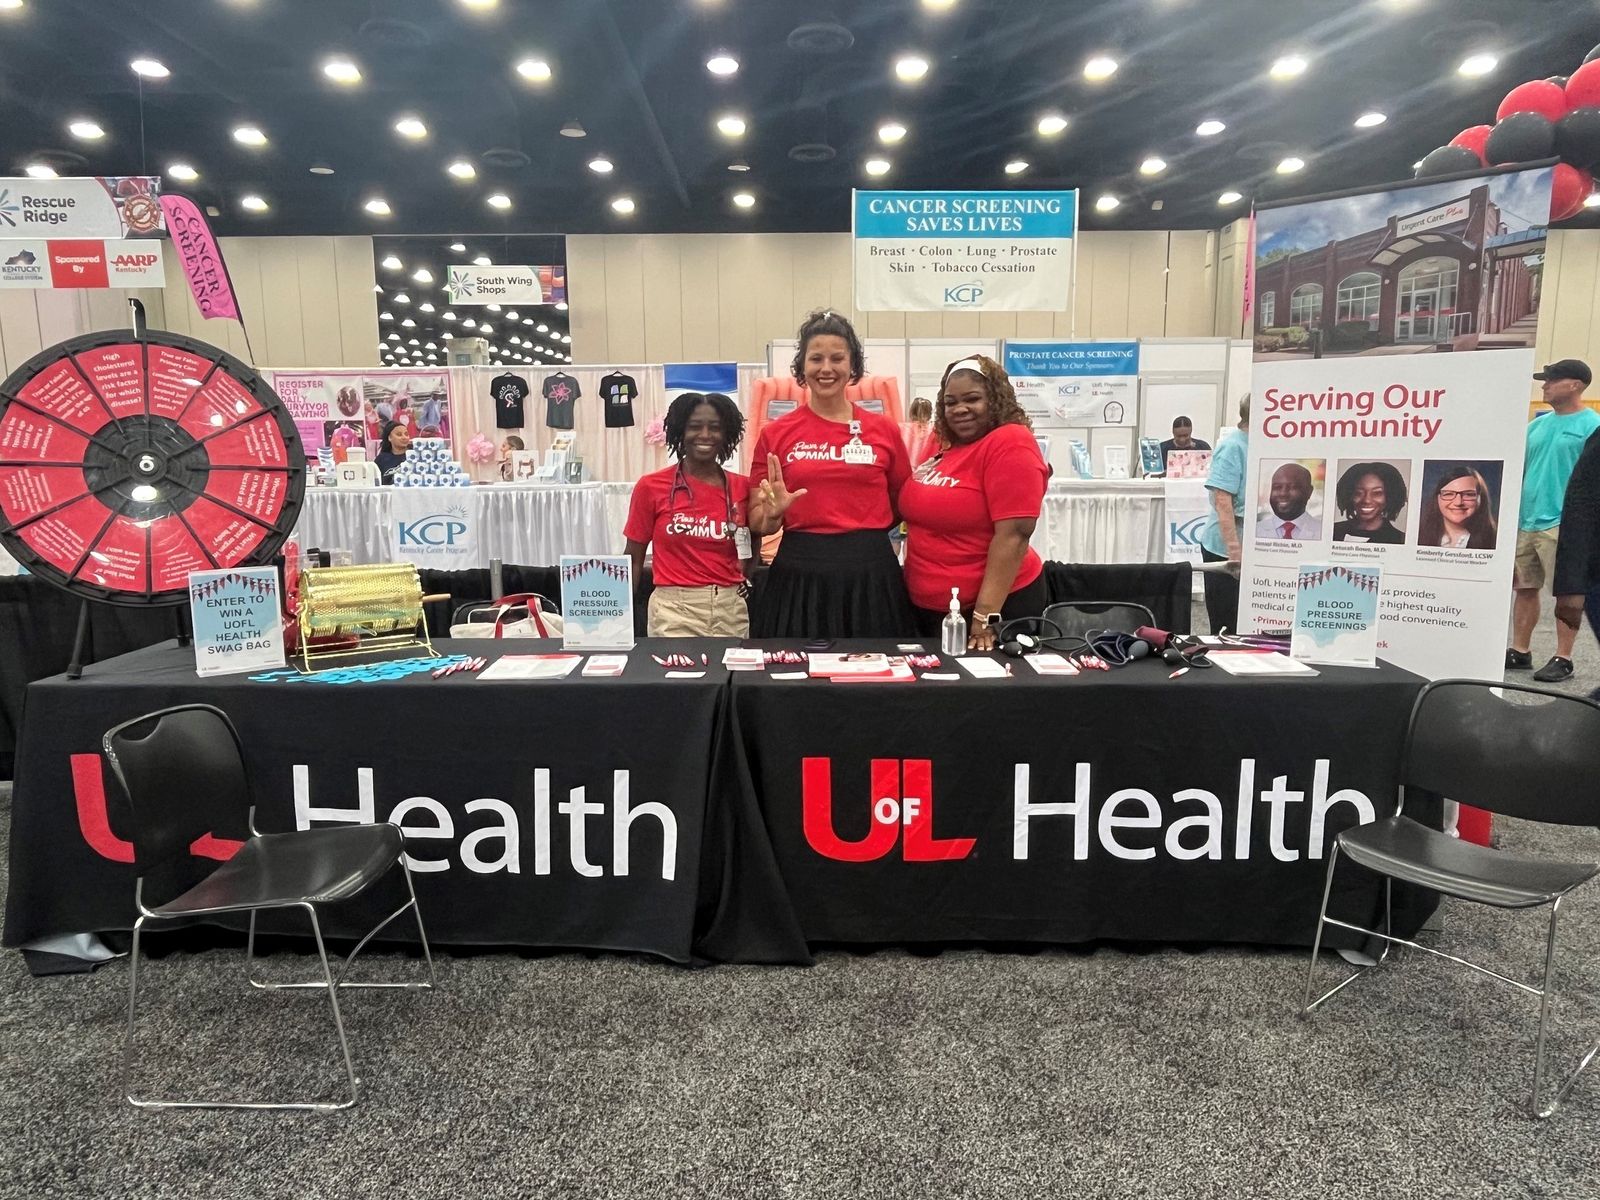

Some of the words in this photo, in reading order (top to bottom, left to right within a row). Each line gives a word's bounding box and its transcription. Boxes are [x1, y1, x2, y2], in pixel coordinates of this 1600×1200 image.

[22, 195, 76, 208] Rescue
[869, 199, 947, 214] CANCER
[952, 199, 1060, 214] SCREENING
[24, 210, 68, 224] Ridge
[1401, 219, 1425, 231] Urgent
[1426, 214, 1445, 224] Care
[906, 217, 963, 232] SAVES
[968, 217, 1022, 232] LIVES
[188, 216, 220, 292] CANCER
[870, 246, 906, 256] Breast
[919, 246, 953, 256] Colon
[967, 245, 997, 259] Lung
[1010, 246, 1057, 256] Prostate
[56, 255, 100, 266] Sponsored
[114, 254, 158, 267] AARP
[169, 206, 212, 312] SCREENING
[73, 265, 84, 274] By
[889, 262, 915, 273] Skin
[932, 262, 978, 273] Tobacco
[981, 262, 1036, 273] Cessation
[476, 276, 504, 286] South
[507, 276, 532, 287] Wing
[476, 285, 506, 295] Shops
[944, 287, 983, 302] KCP
[102, 353, 120, 361] High
[1086, 350, 1133, 358] SCREENING
[93, 360, 135, 372] cholesterol
[96, 372, 118, 381] levels
[102, 382, 116, 390] risk
[116, 379, 139, 388] factor
[118, 388, 141, 397] which
[111, 397, 142, 408] disease?
[1264, 387, 1374, 416] Serving
[1383, 384, 1446, 410] Our
[1262, 413, 1443, 444] Community
[793, 442, 818, 452] Power
[819, 442, 828, 452] of
[699, 516, 708, 526] of
[398, 520, 466, 545] KCP
[1171, 522, 1206, 545] KC
[1252, 578, 1271, 587] UofL
[1274, 580, 1297, 588] Healt
[1252, 590, 1286, 600] patients
[1394, 588, 1436, 599] provides
[206, 597, 246, 608] ENTER
[250, 595, 264, 604] TO
[1251, 602, 1284, 611] medical
[1317, 600, 1354, 609] BLOOD
[219, 607, 242, 618] WIN
[244, 607, 253, 616] A
[1387, 600, 1424, 611] highest
[1426, 604, 1462, 616] quality
[1307, 610, 1362, 620] PRESSURE
[224, 619, 255, 630] UOFL
[1257, 616, 1292, 628] Primary
[1301, 621, 1367, 631] SCREENINGS
[1402, 614, 1468, 629] convenience.
[216, 630, 262, 642] HEALTH
[208, 643, 243, 654] SWAG
[246, 640, 271, 650] BAG
[874, 796, 921, 826] OF
[1013, 759, 1378, 860] Health
[292, 764, 678, 880] Health
